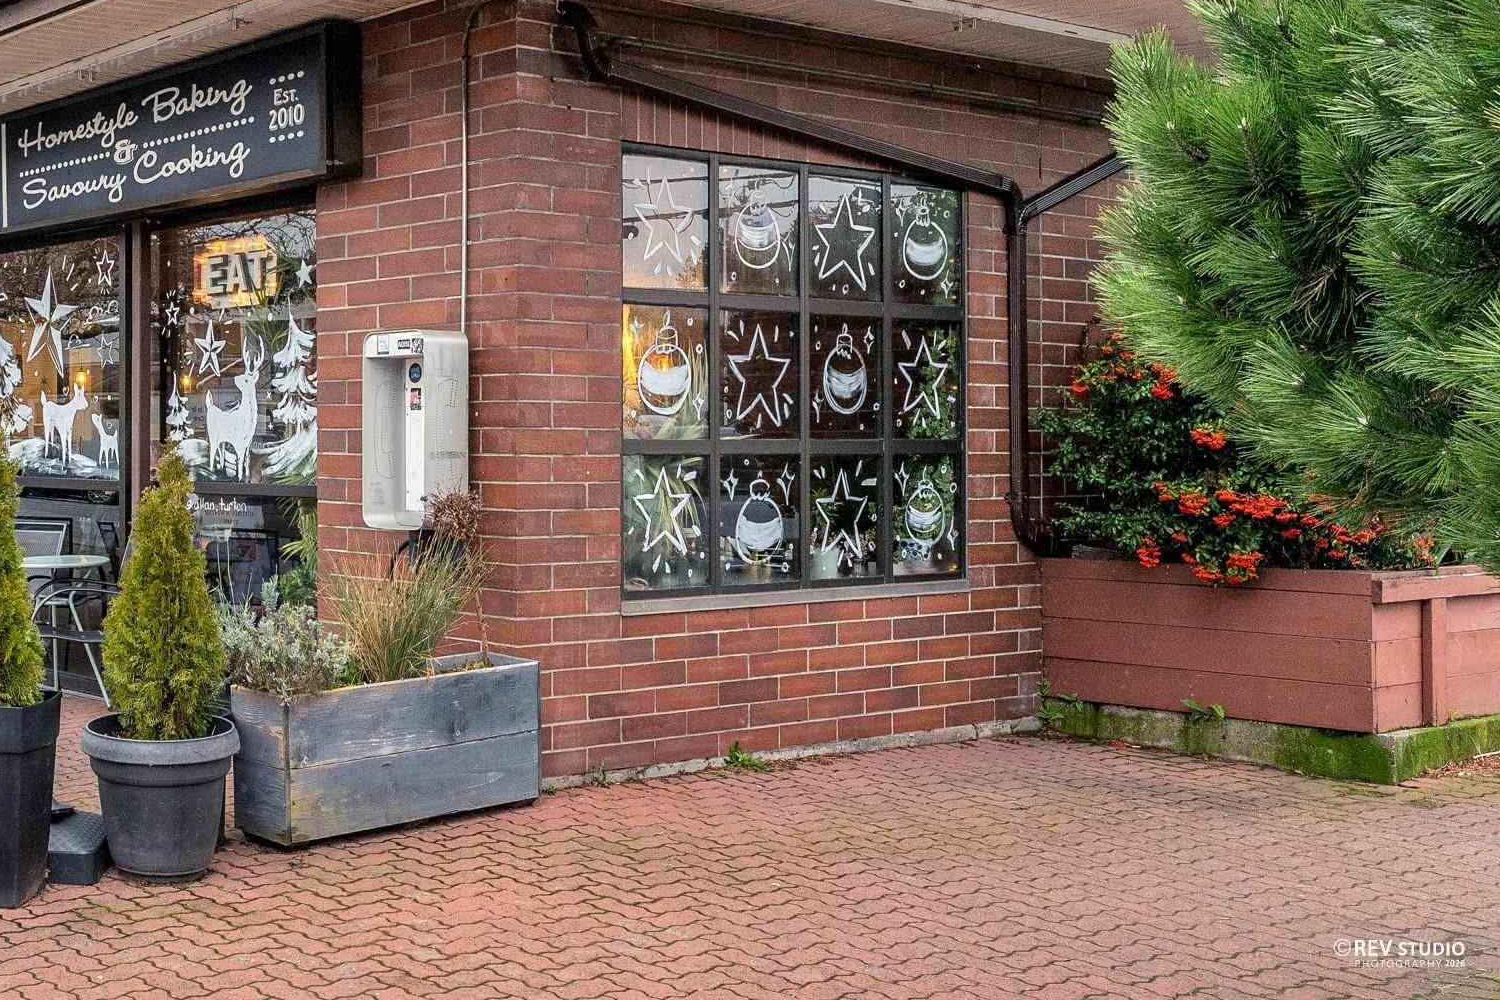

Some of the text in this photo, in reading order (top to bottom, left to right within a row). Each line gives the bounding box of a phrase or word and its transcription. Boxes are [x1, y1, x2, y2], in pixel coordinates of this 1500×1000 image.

[18, 79, 253, 157] Homestyle Baking
[269, 104, 305, 131] 2010
[114, 139, 137, 164] &
[20, 142, 250, 209] Savoury Cooking
[207, 249, 267, 295] EAT
